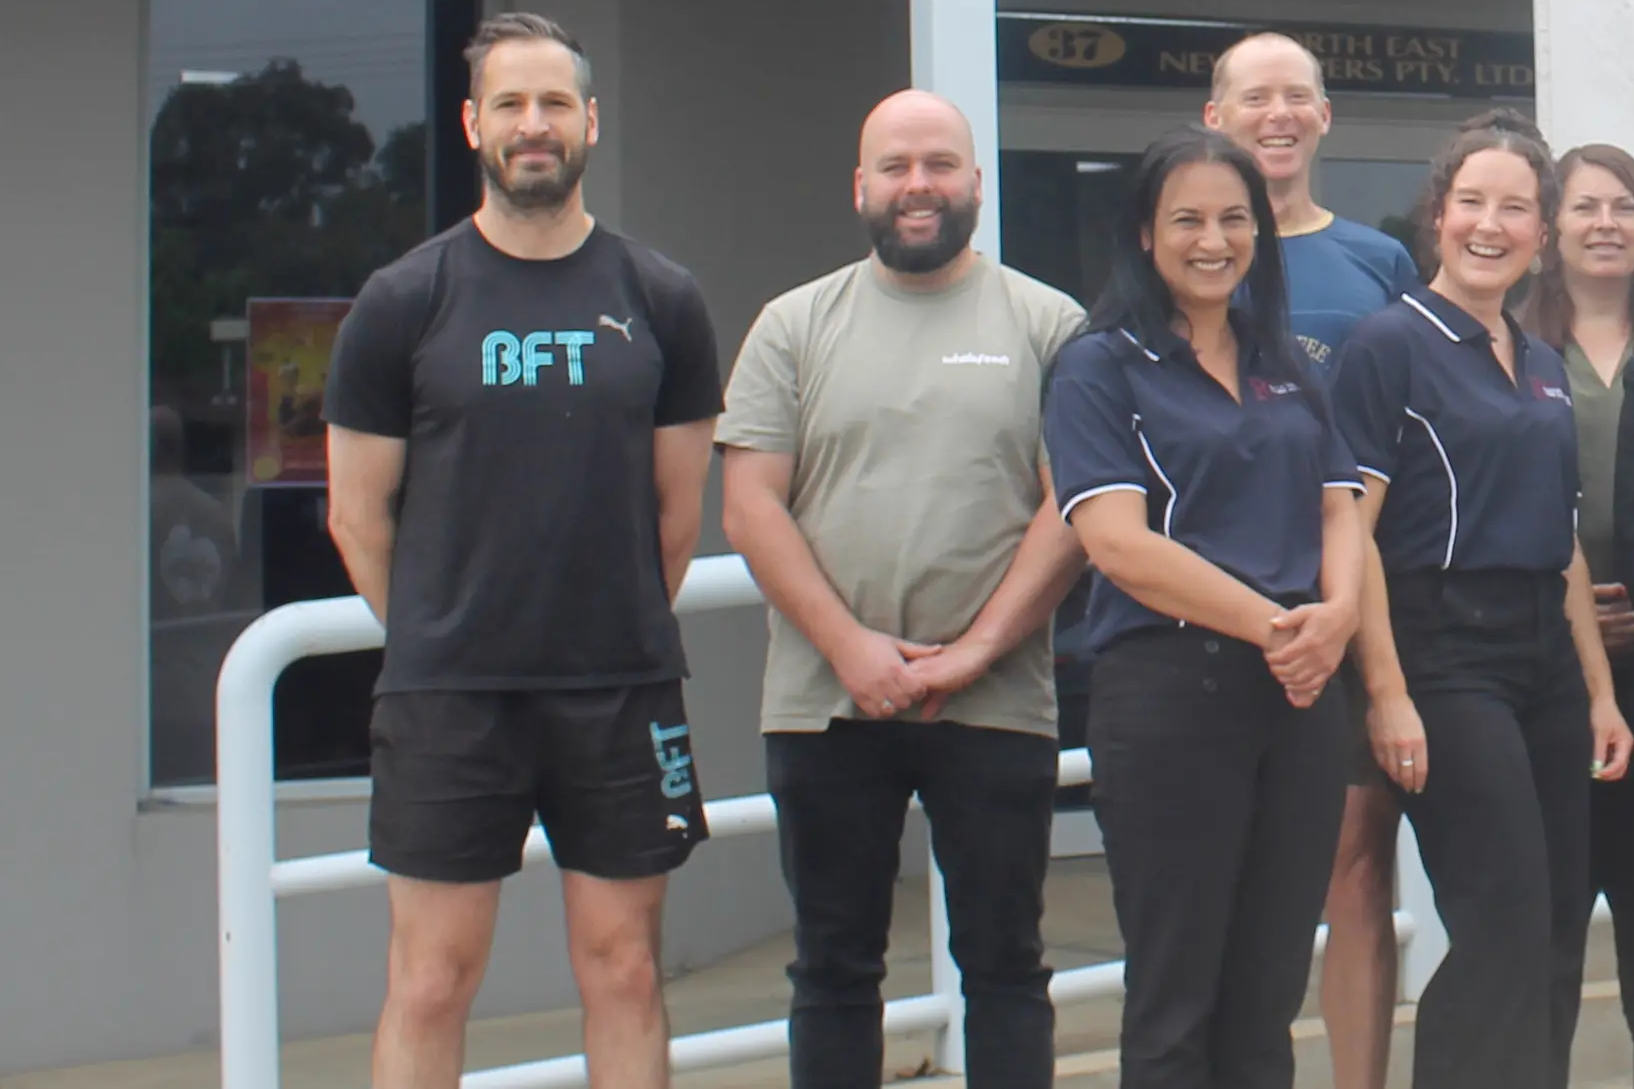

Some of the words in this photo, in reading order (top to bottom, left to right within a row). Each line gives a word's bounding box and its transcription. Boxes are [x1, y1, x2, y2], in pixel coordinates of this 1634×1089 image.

[1047, 29, 1103, 61] 37
[1386, 35, 1463, 60] EAST
[1395, 60, 1462, 85] PTY.
[1474, 63, 1534, 86] LTD
[481, 329, 595, 387] BFT
[649, 720, 693, 799] BFT
